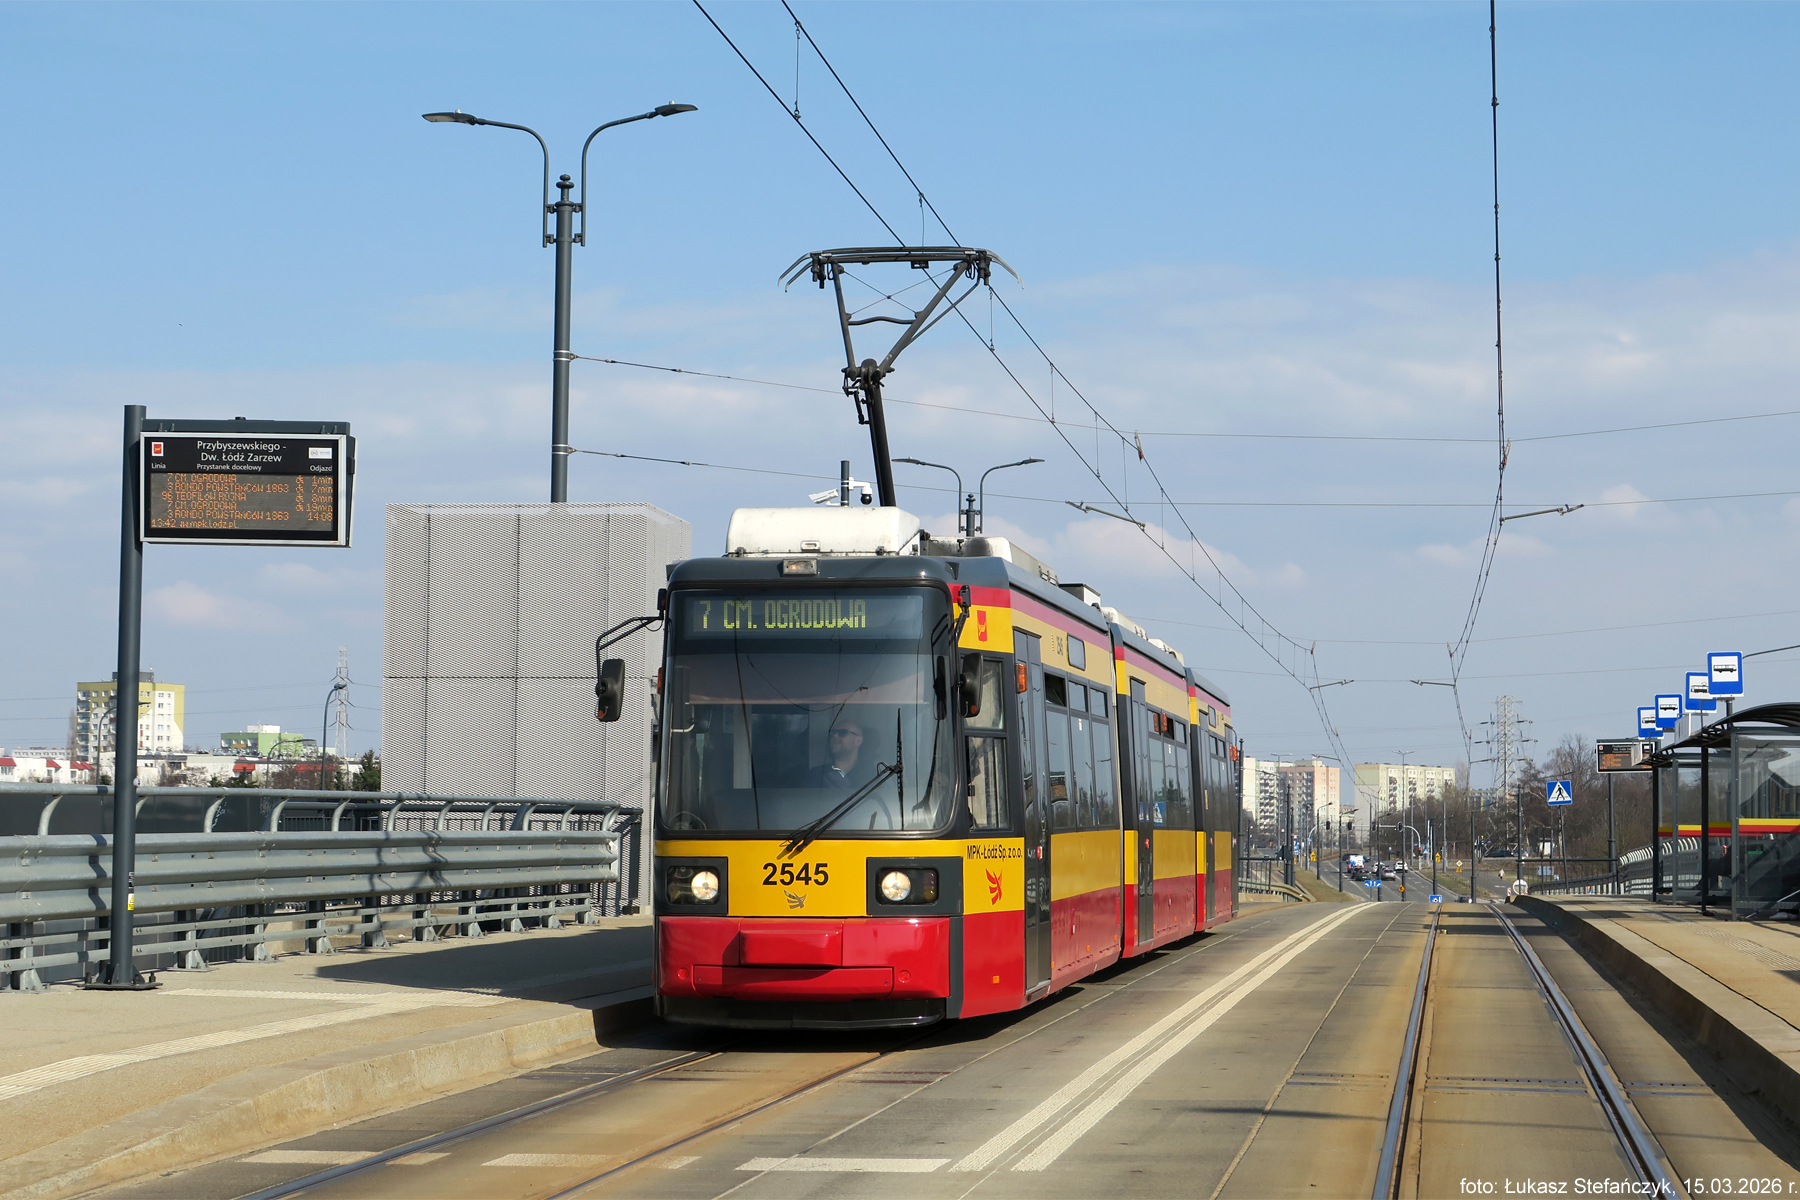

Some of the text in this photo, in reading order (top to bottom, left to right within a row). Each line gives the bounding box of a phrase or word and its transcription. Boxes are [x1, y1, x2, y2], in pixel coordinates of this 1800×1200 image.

[197, 440, 280, 452] Przybyszewskiego
[201, 452, 282, 462] Dw. Łódź Zarzew
[196, 463, 262, 472] Przystanek docelowy
[310, 465, 333, 473] Odjazd
[167, 473, 173, 482] 7
[190, 473, 237, 483] OGRODOWA
[167, 482, 173, 491] 3
[174, 482, 204, 491] RONDO
[266, 484, 290, 493] 1863
[218, 492, 247, 501] ROJNA
[167, 501, 173, 509] 7
[190, 501, 237, 510] OGRODOWA
[167, 510, 173, 518] 3
[174, 510, 203, 519] RONDO
[266, 511, 290, 521] 1863
[151, 519, 176, 528] 13:42
[699, 599, 866, 629] 7 CM. OGRODOWA
[967, 844, 998, 860] MPK-Łódź
[998, 844, 1008, 862] Sp.
[1012, 847, 1023, 859] o.o.
[762, 862, 829, 887] 2545
